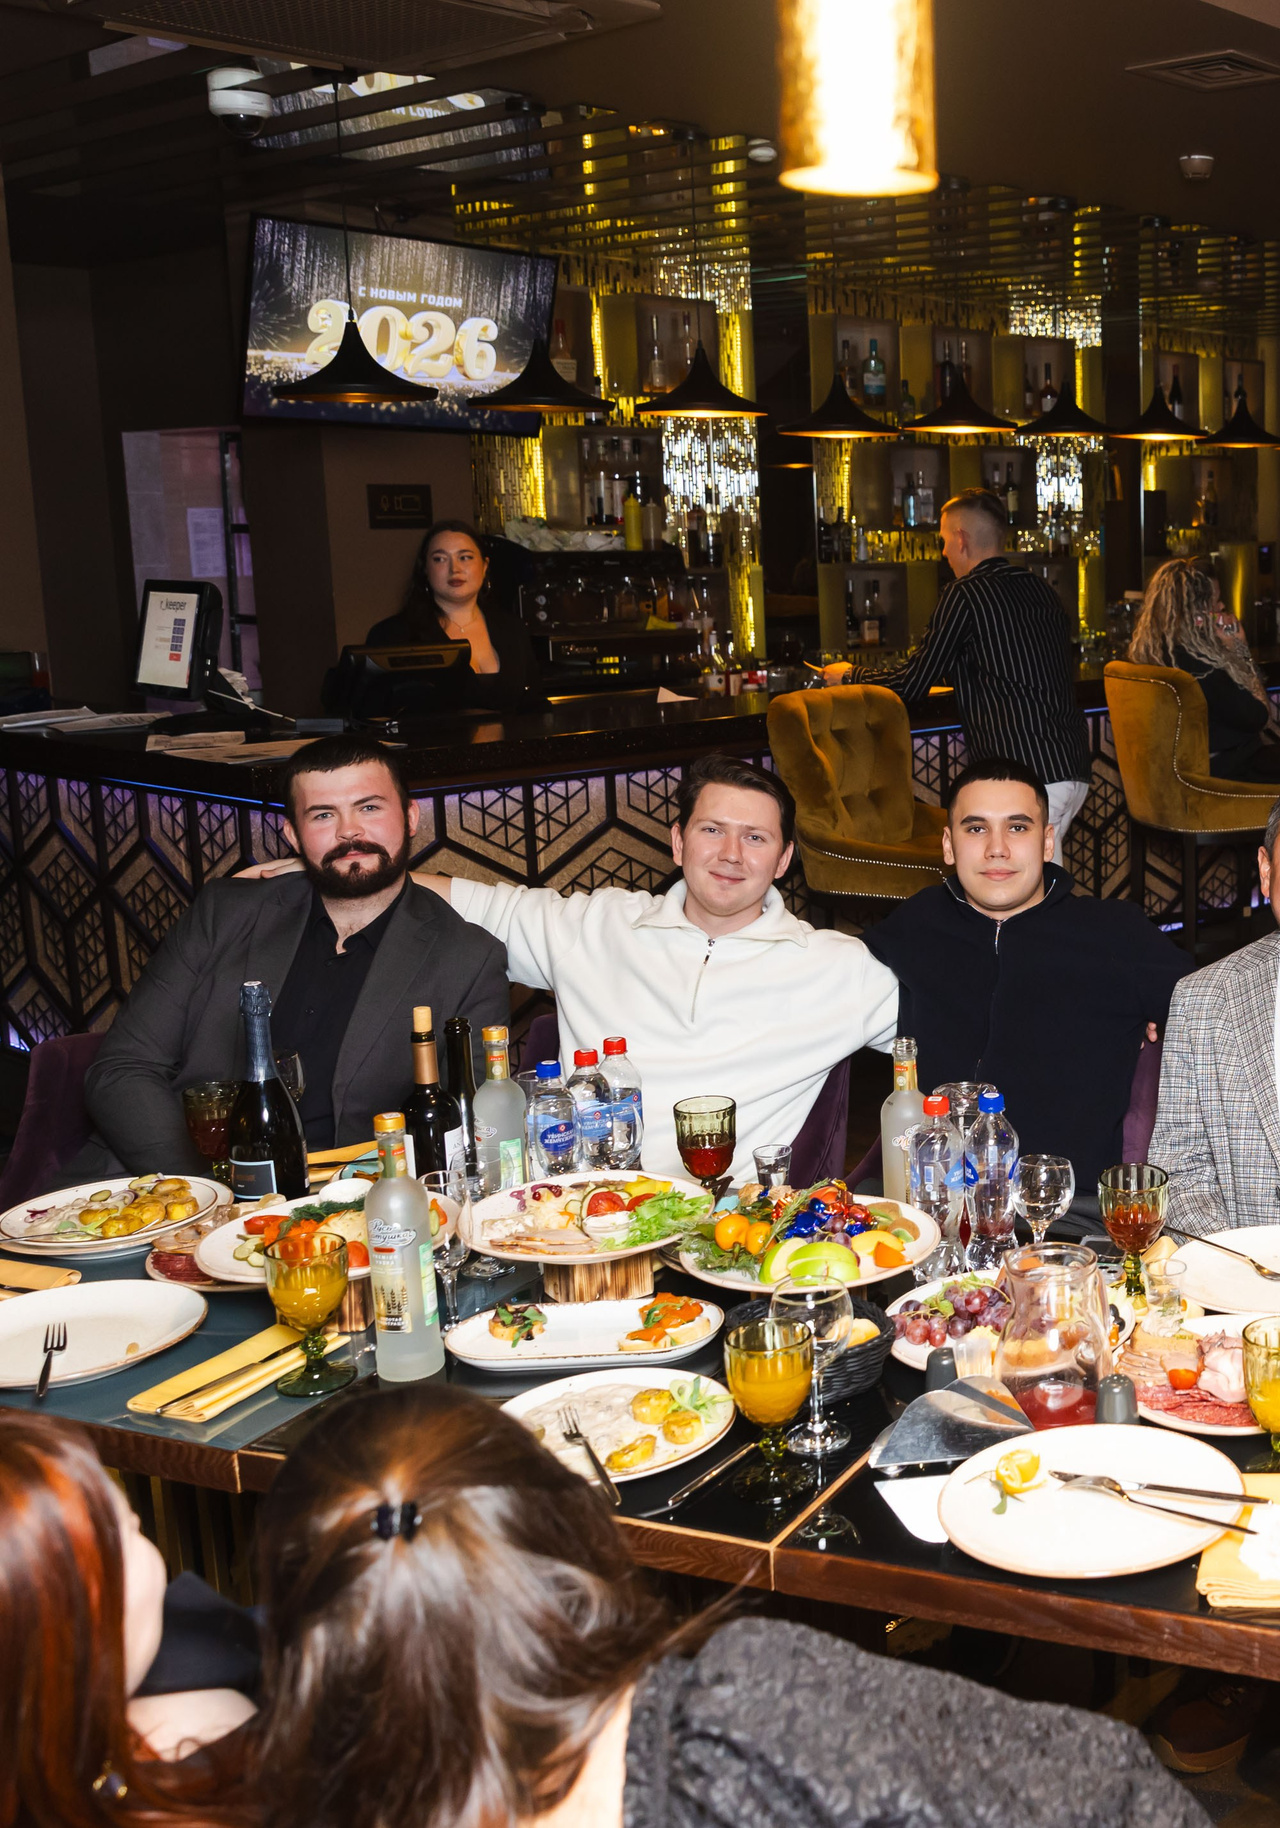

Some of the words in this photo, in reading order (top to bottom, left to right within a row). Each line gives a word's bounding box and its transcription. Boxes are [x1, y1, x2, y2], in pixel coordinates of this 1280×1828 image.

[358, 286, 366, 297] С
[370, 287, 417, 303] НОВЫМ
[421, 293, 463, 308] ГОДОМ
[305, 298, 498, 380] 2026
